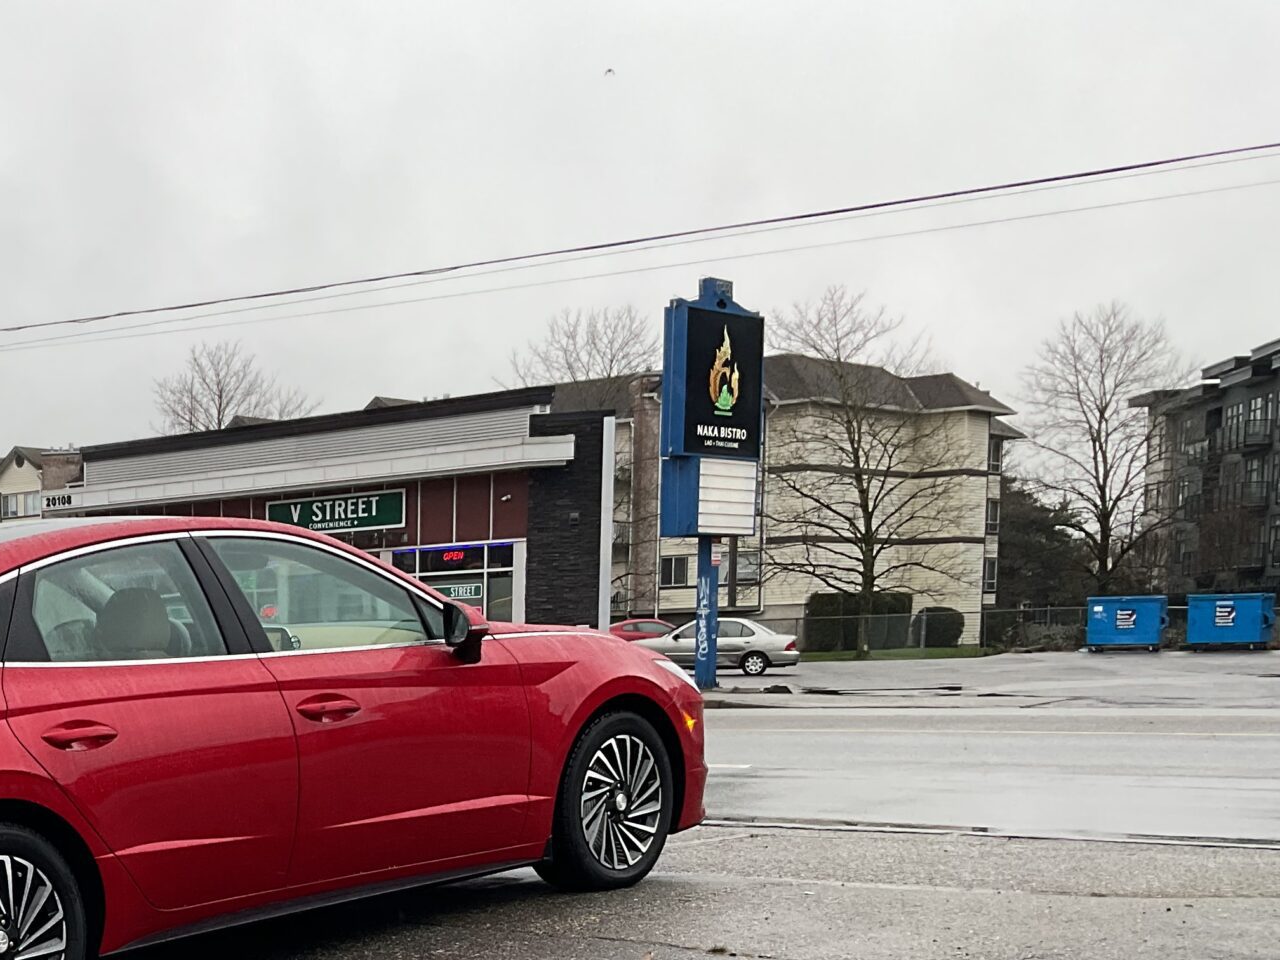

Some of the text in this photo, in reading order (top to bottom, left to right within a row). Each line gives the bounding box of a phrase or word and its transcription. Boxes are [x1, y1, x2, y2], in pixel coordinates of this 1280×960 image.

[697, 424, 747, 440] NAKA BISTRO
[46, 495, 72, 507] 20108
[290, 496, 380, 523] V STREET
[308, 520, 352, 530] CONVENIENCE
[443, 551, 464, 560] OPEN
[450, 586, 475, 597] STREET
